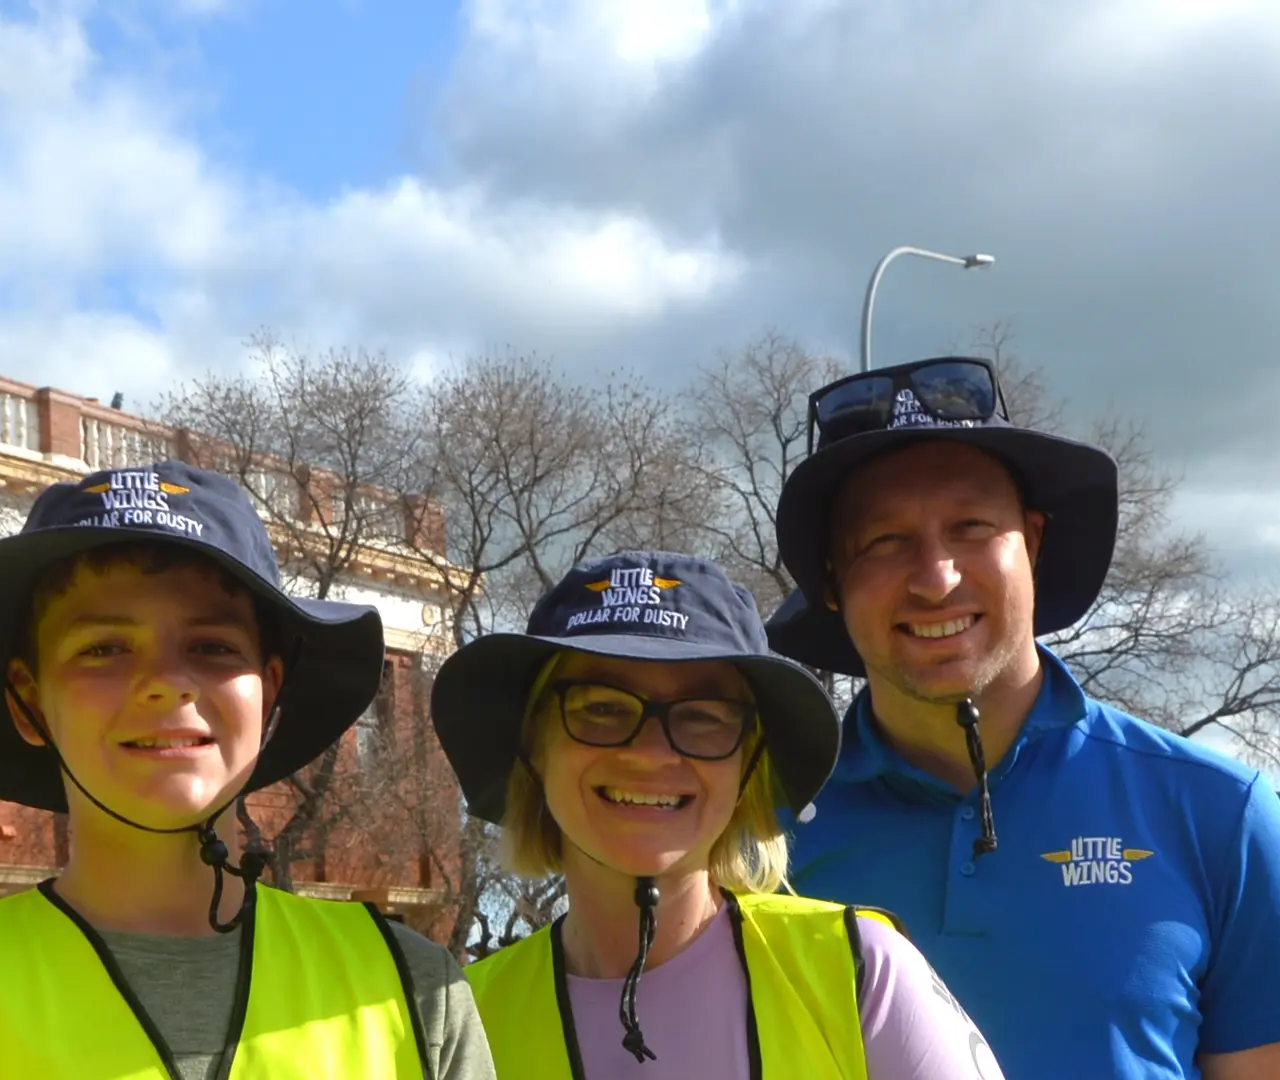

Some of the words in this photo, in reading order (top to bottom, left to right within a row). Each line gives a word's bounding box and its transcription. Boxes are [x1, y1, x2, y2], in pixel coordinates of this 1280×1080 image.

[111, 471, 160, 491] LITTLE
[101, 489, 169, 511] WINGS
[124, 509, 153, 524] FOR
[156, 511, 203, 537] DUSTY
[610, 567, 654, 588] LITTLE
[601, 586, 661, 607] WINGS
[566, 608, 611, 630] DOLLAR
[613, 606, 641, 622] FOR
[643, 608, 689, 630] DUSTY
[1071, 836, 1122, 861] LITTLE
[1061, 861, 1133, 887] WINGS
